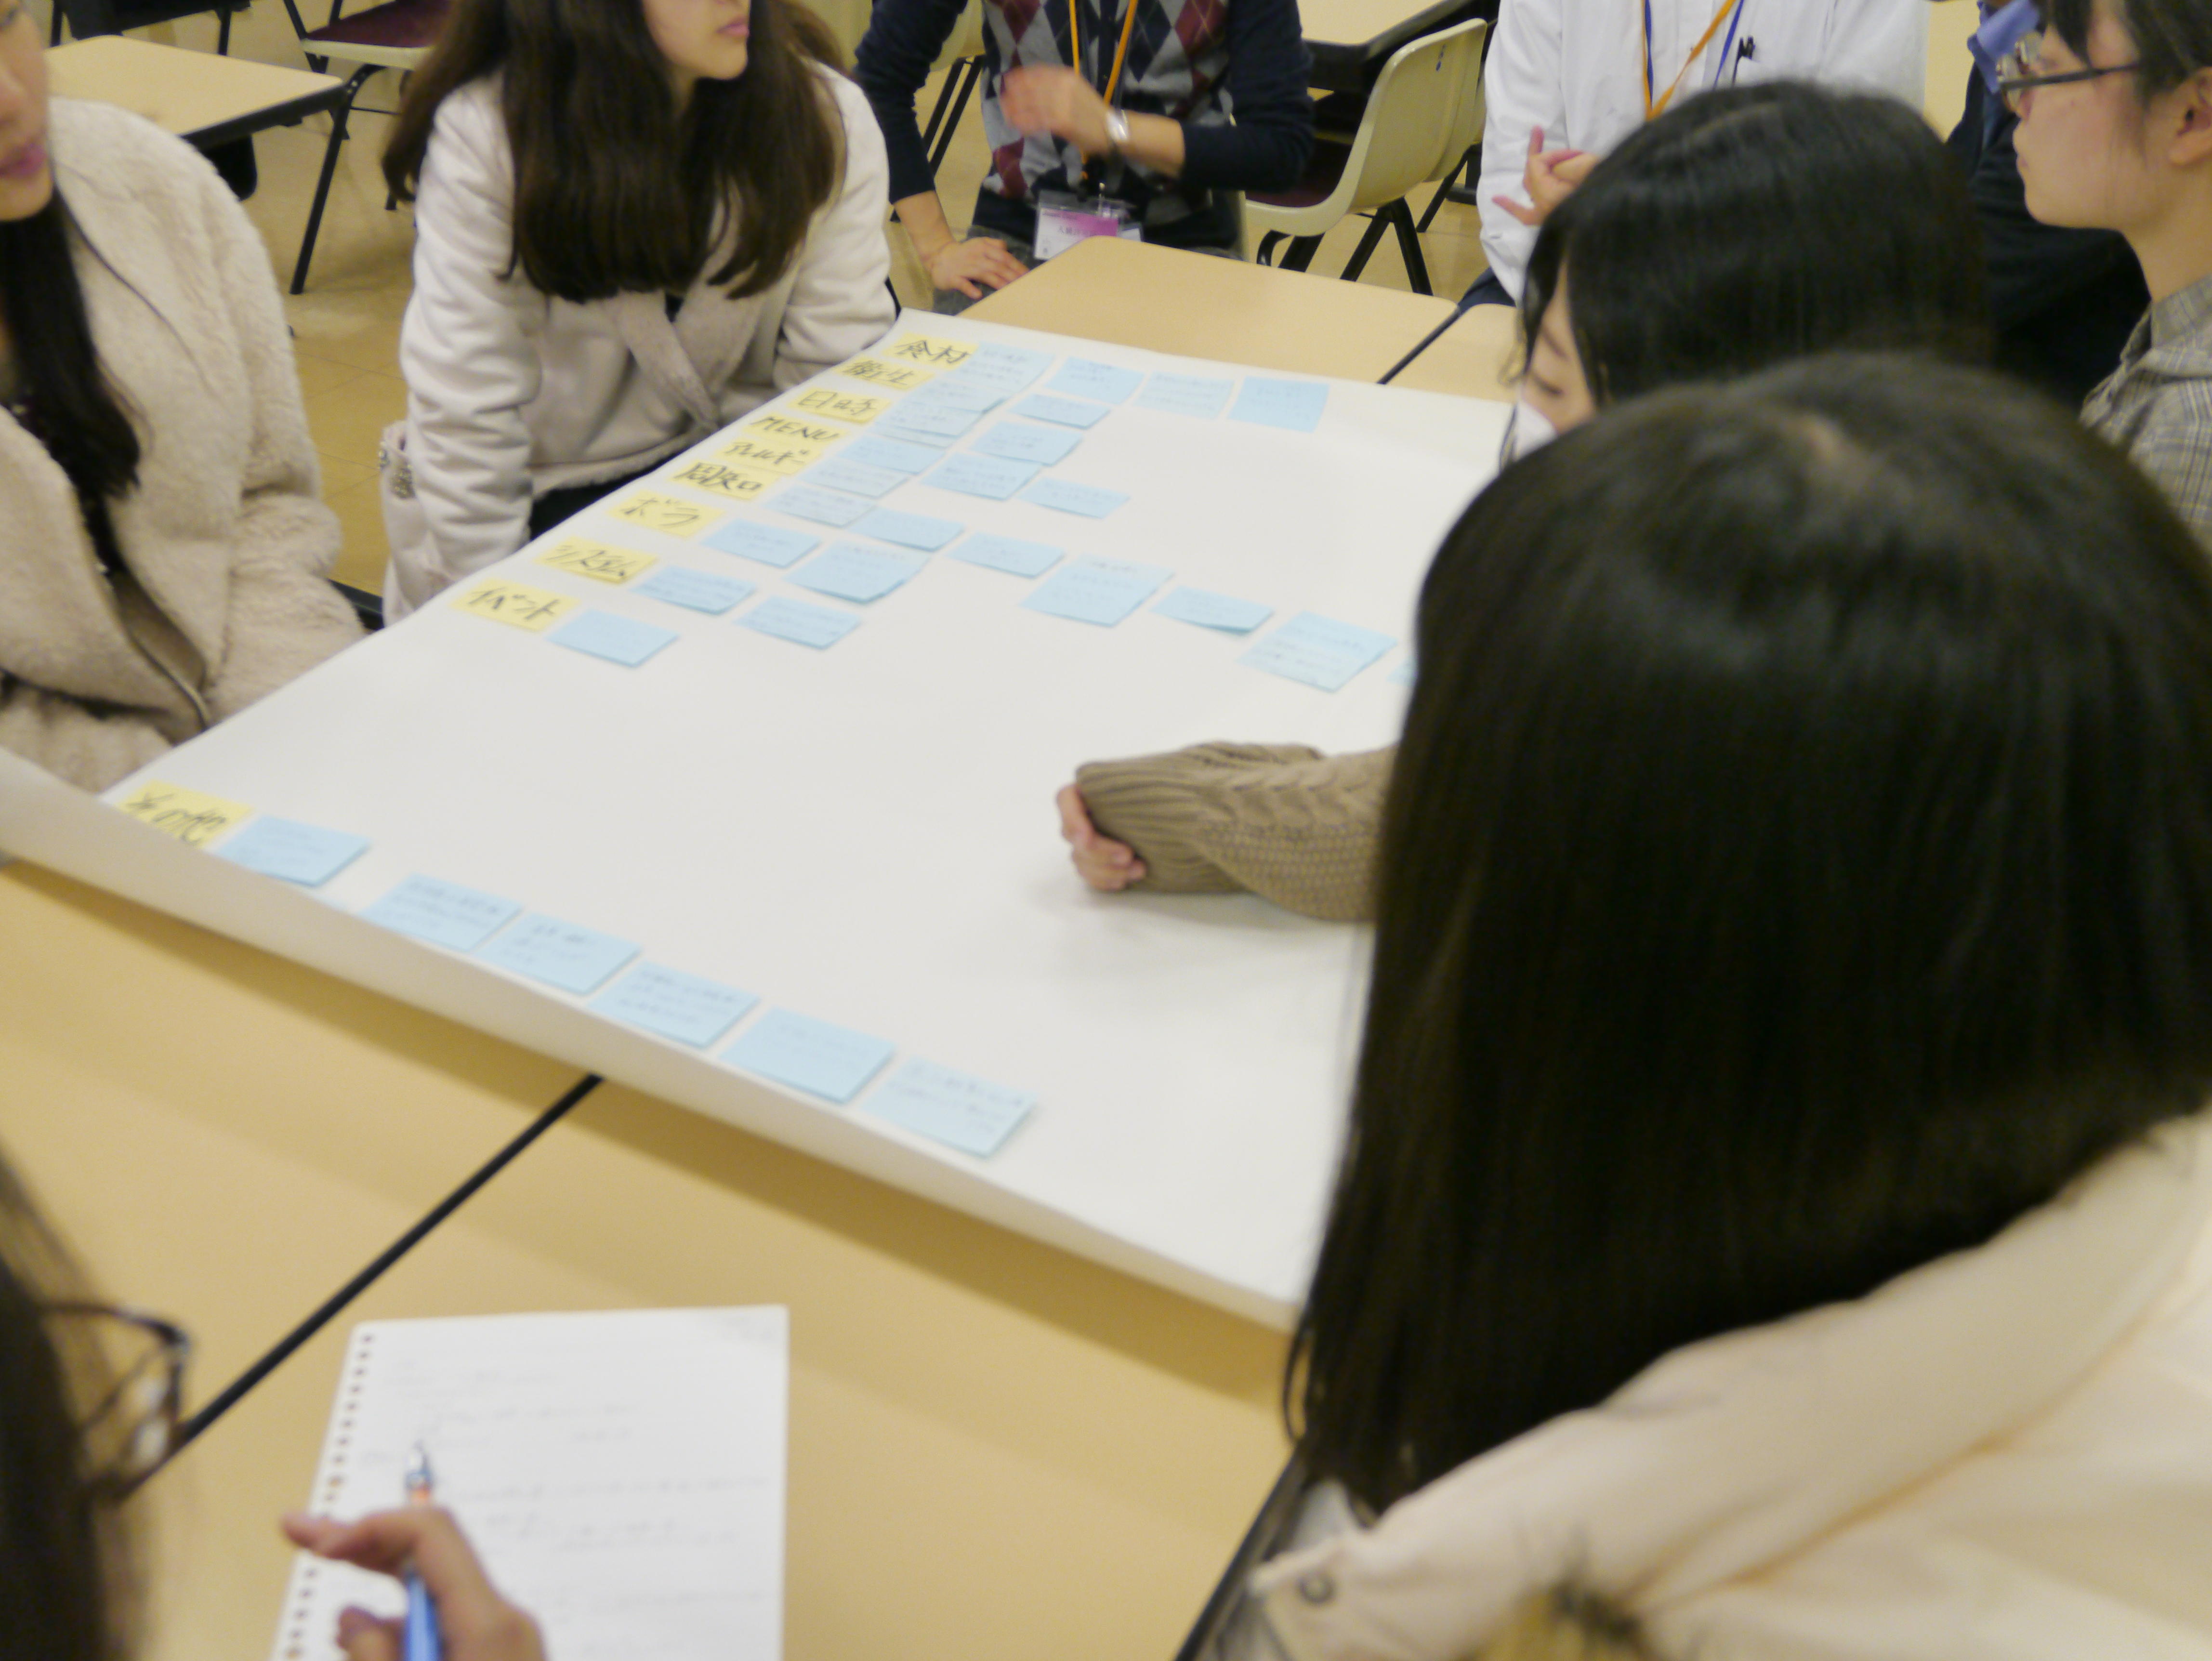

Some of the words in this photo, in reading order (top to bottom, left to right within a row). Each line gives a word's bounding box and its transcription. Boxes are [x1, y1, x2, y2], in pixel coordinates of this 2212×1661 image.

[891, 340, 973, 364] 食材
[750, 416, 841, 441] MENU
[620, 497, 700, 527] ボラ
